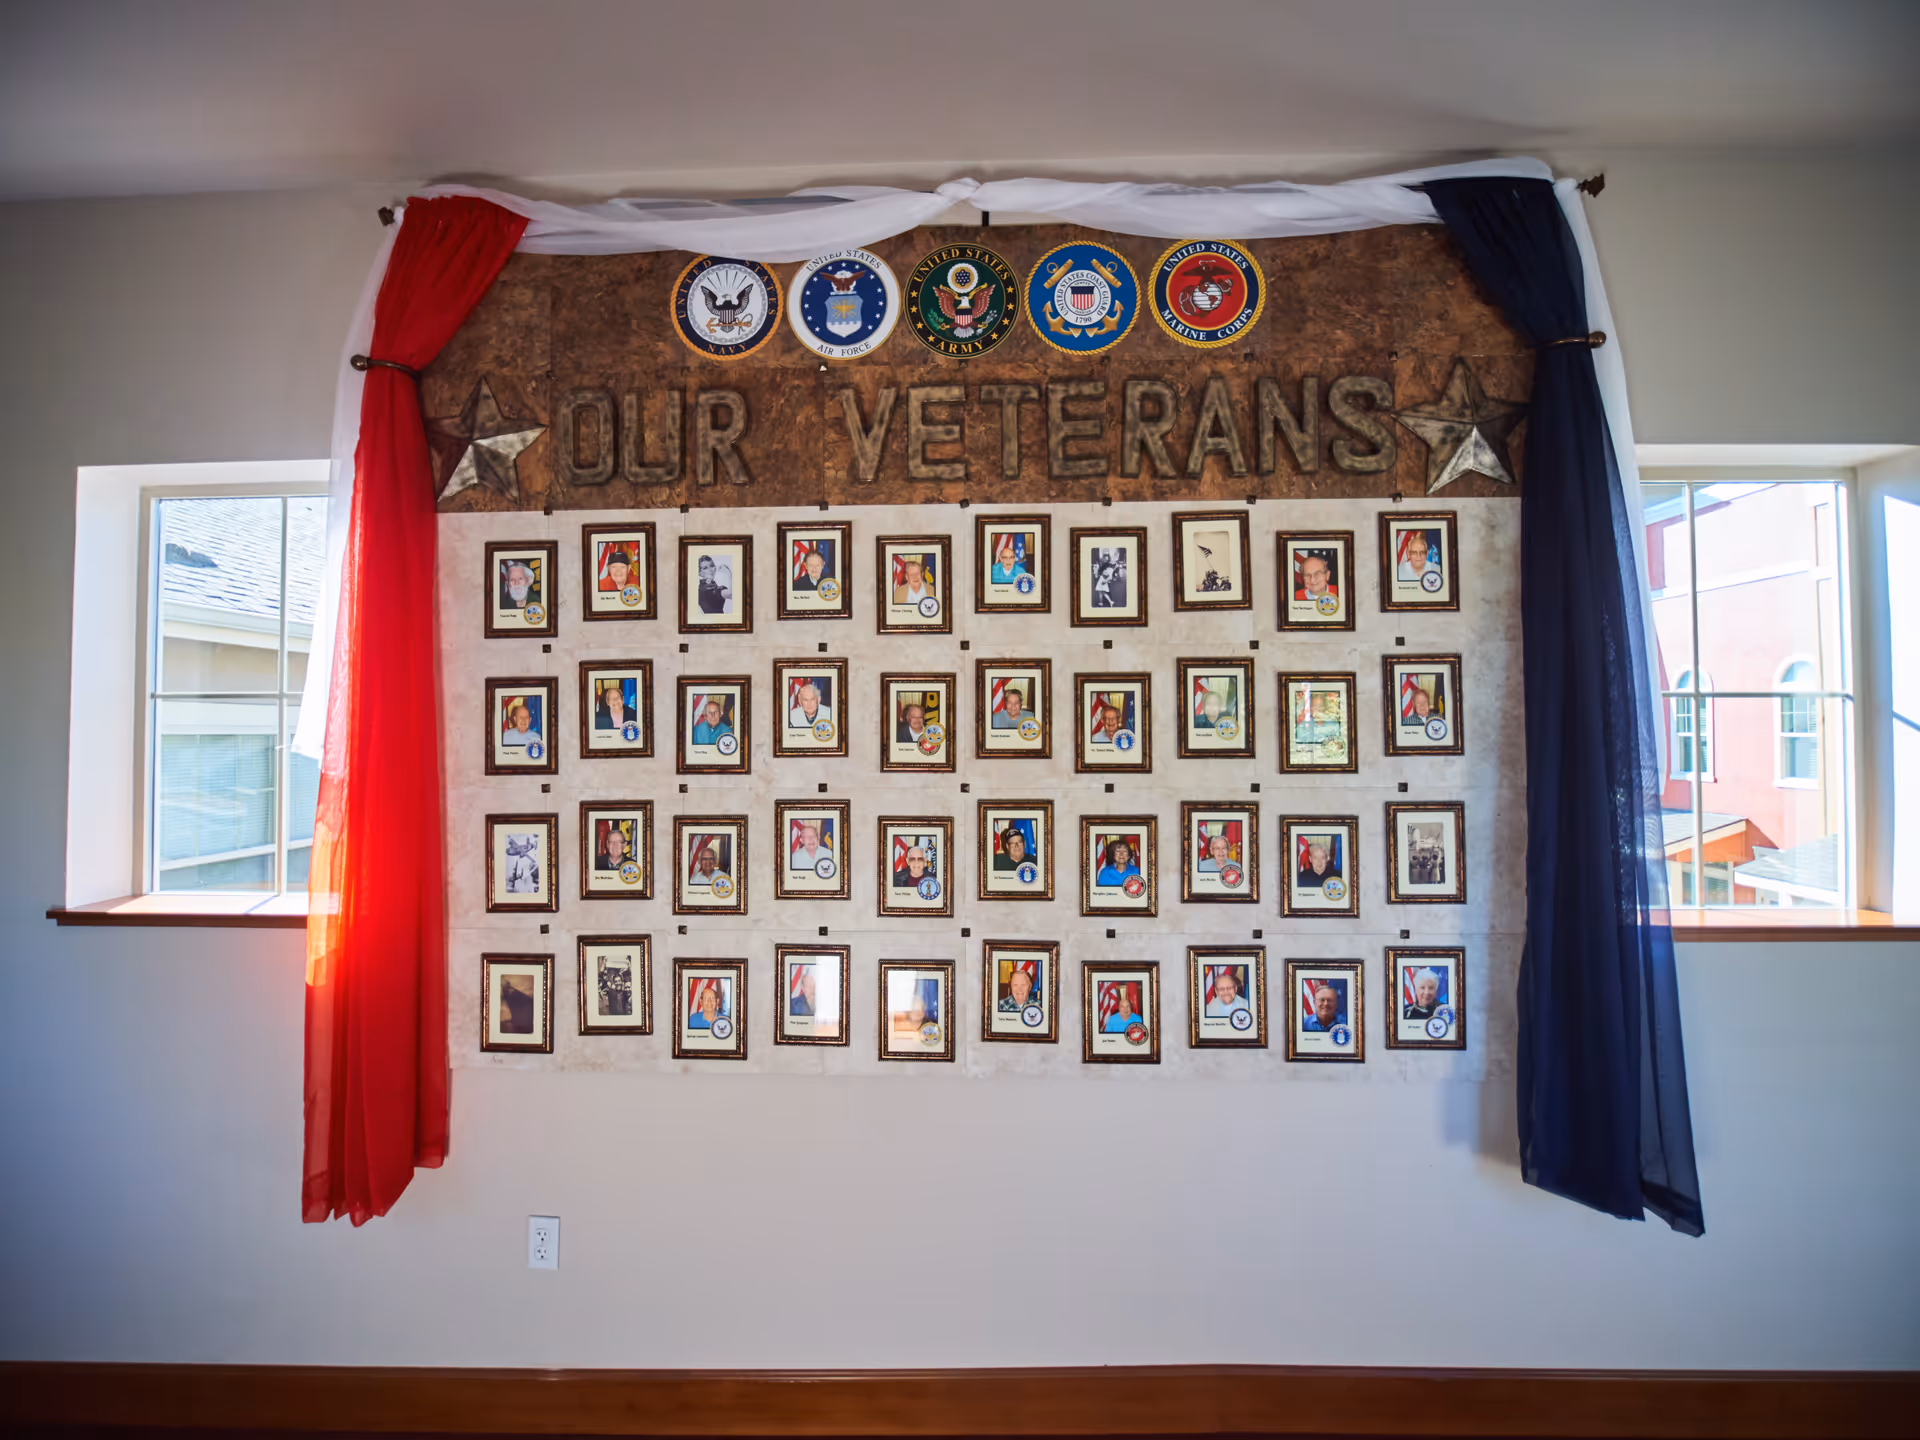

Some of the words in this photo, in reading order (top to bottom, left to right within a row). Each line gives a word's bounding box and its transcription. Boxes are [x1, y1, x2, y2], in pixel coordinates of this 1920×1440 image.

[846, 249, 882, 270] STATES
[914, 248, 960, 282] UNITED
[965, 248, 1010, 280] STATES
[1163, 243, 1205, 272] UNITED
[1210, 243, 1249, 269] STATES
[678, 260, 712, 319] UNITED
[744, 260, 776, 315] STATES
[1061, 272, 1085, 288] STATES
[1086, 272, 1107, 289] COAST
[1056, 289, 1068, 316] UNITED
[1097, 290, 1109, 316] GUARD
[1075, 316, 1092, 324] 1790
[1161, 309, 1207, 341] MARINE
[1217, 307, 1253, 339] CORPS
[708, 344, 746, 355] NAVY
[817, 344, 834, 356] AIR
[841, 341, 872, 357] FORCE
[936, 340, 984, 354] ARMY
[557, 388, 748, 486] OUR
[839, 375, 1396, 481] VETERANS
